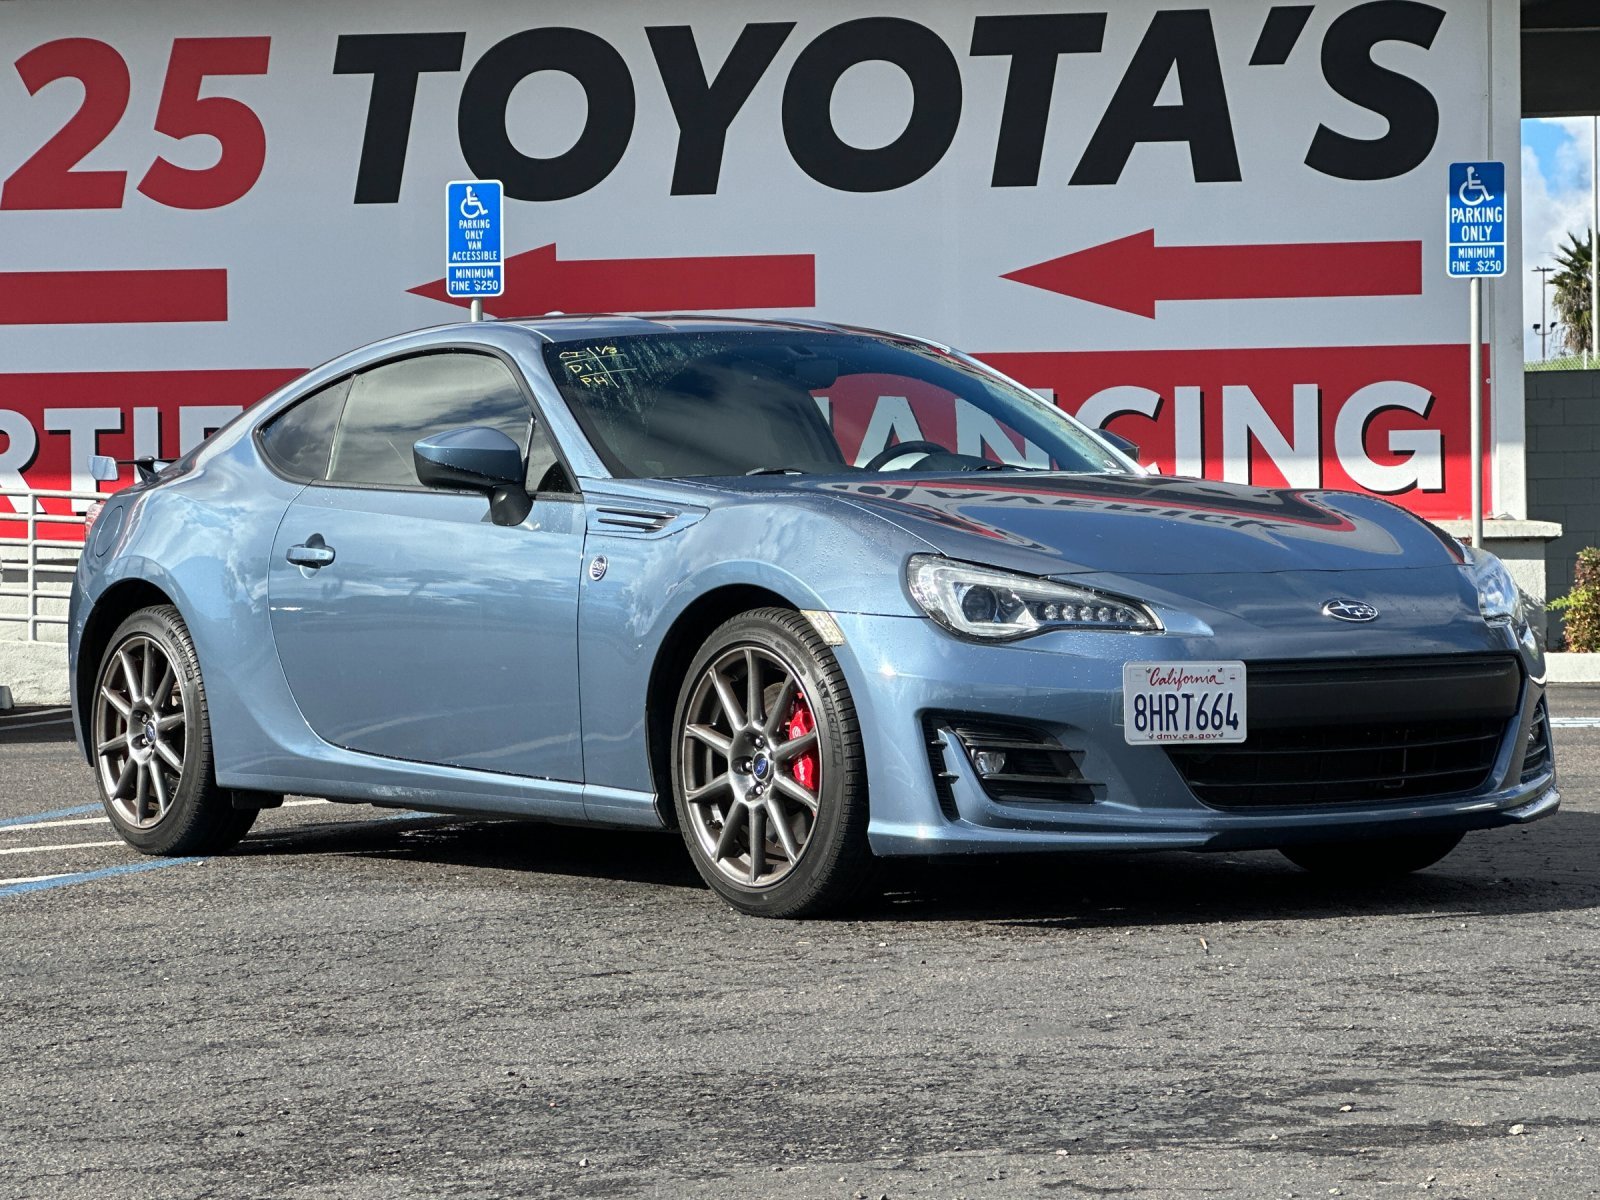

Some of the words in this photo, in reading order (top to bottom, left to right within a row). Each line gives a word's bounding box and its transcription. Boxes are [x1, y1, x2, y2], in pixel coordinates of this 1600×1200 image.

[0, 38, 271, 210] 25
[332, 0, 1446, 204] TOYOTA'S
[1451, 207, 1503, 223] PARKING
[458, 219, 491, 229] PARKING
[464, 230, 484, 240] ONLY
[1461, 225, 1493, 242] ONLY
[467, 241, 482, 250] VAN
[451, 251, 498, 261] ACCESSIBLE
[1458, 248, 1495, 258] MINIMUM
[1451, 261, 1471, 272] FINE
[1476, 260, 1502, 272] $250
[455, 268, 494, 279] MINIMUM
[450, 281, 470, 291] FINE
[474, 280, 499, 291] $250
[1149, 667, 1224, 692] California
[1134, 692, 1239, 732] 8HRT664
[1156, 732, 1218, 740] dmv.ca.gov
